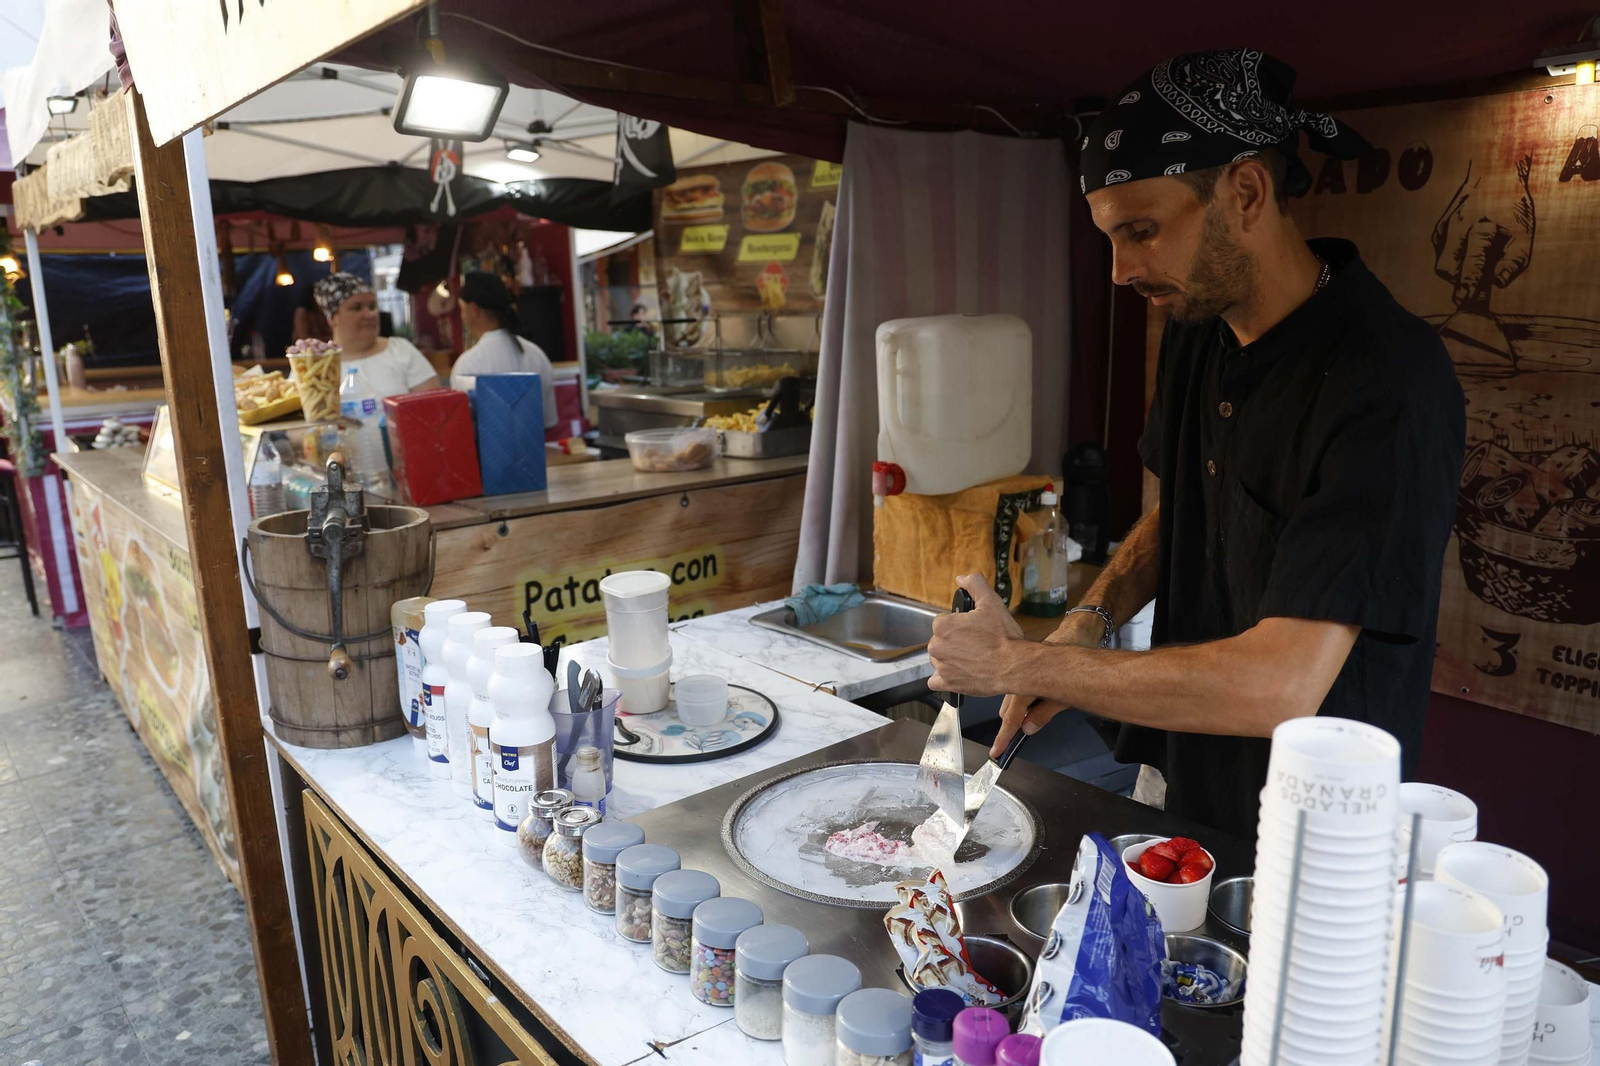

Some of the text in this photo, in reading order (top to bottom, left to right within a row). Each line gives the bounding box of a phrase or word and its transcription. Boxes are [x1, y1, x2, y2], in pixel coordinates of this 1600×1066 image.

[1313, 140, 1434, 195] ADO
[524, 553, 718, 617] Pata con
[1473, 625, 1521, 678] 3
[1552, 645, 1600, 670] ELIG
[1536, 667, 1600, 698] TOPPI
[494, 782, 533, 794] CHOCOLATE
[1276, 770, 1387, 800] GRANADA
[1280, 786, 1378, 815] HELADOS
